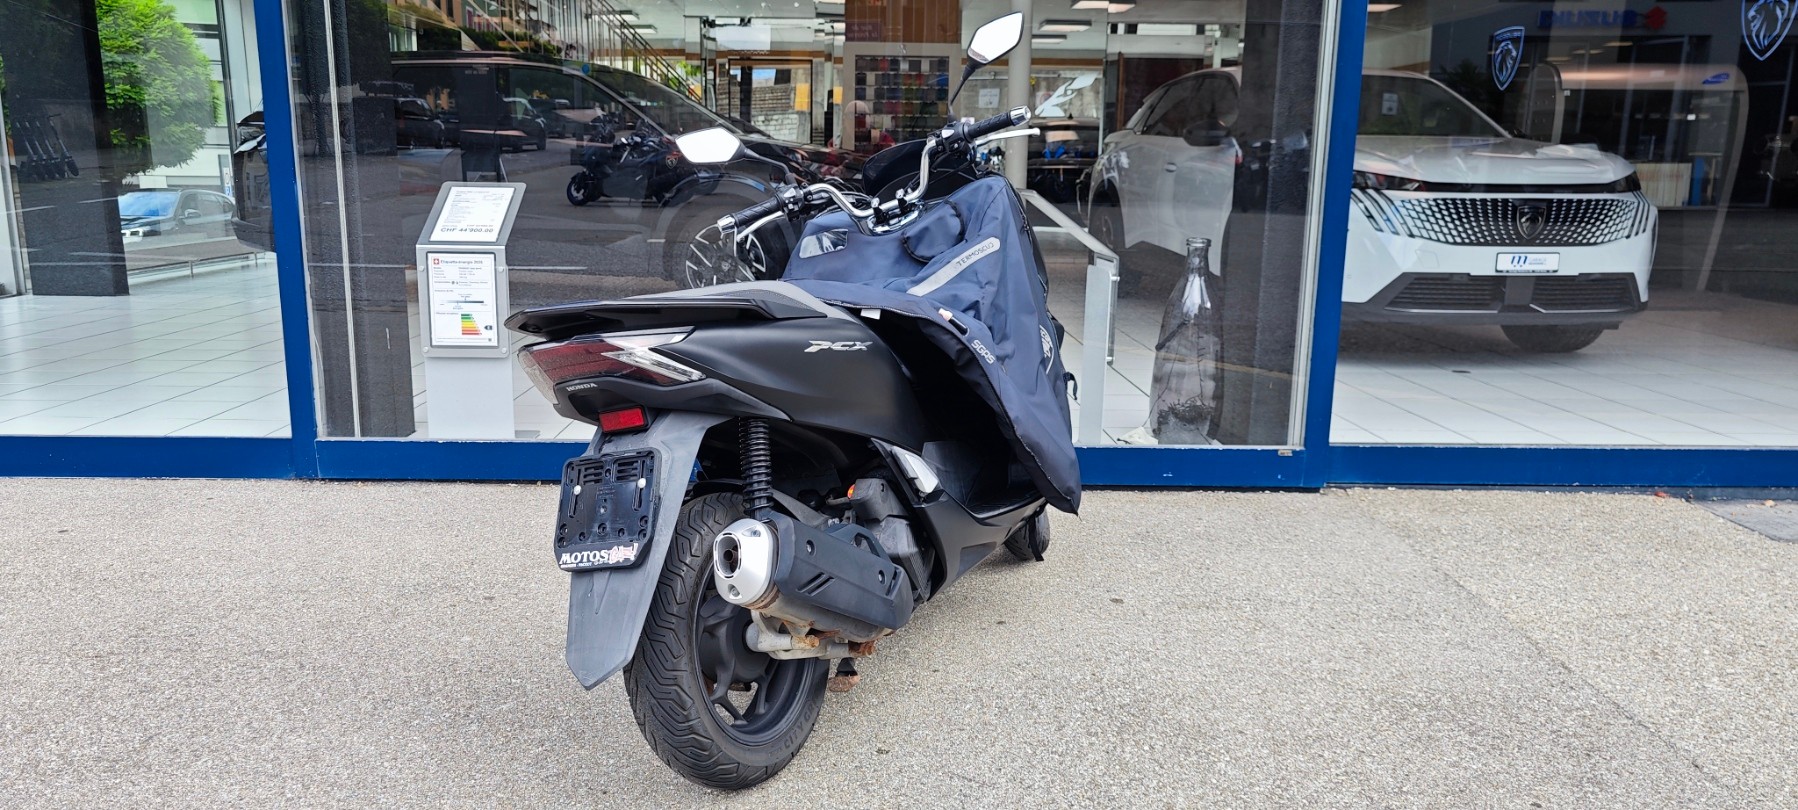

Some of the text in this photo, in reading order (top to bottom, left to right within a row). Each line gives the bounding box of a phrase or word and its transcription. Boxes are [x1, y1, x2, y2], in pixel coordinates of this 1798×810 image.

[804, 340, 873, 352] PCX
[565, 382, 598, 392] HONDA
[783, 721, 804, 749] CITY
